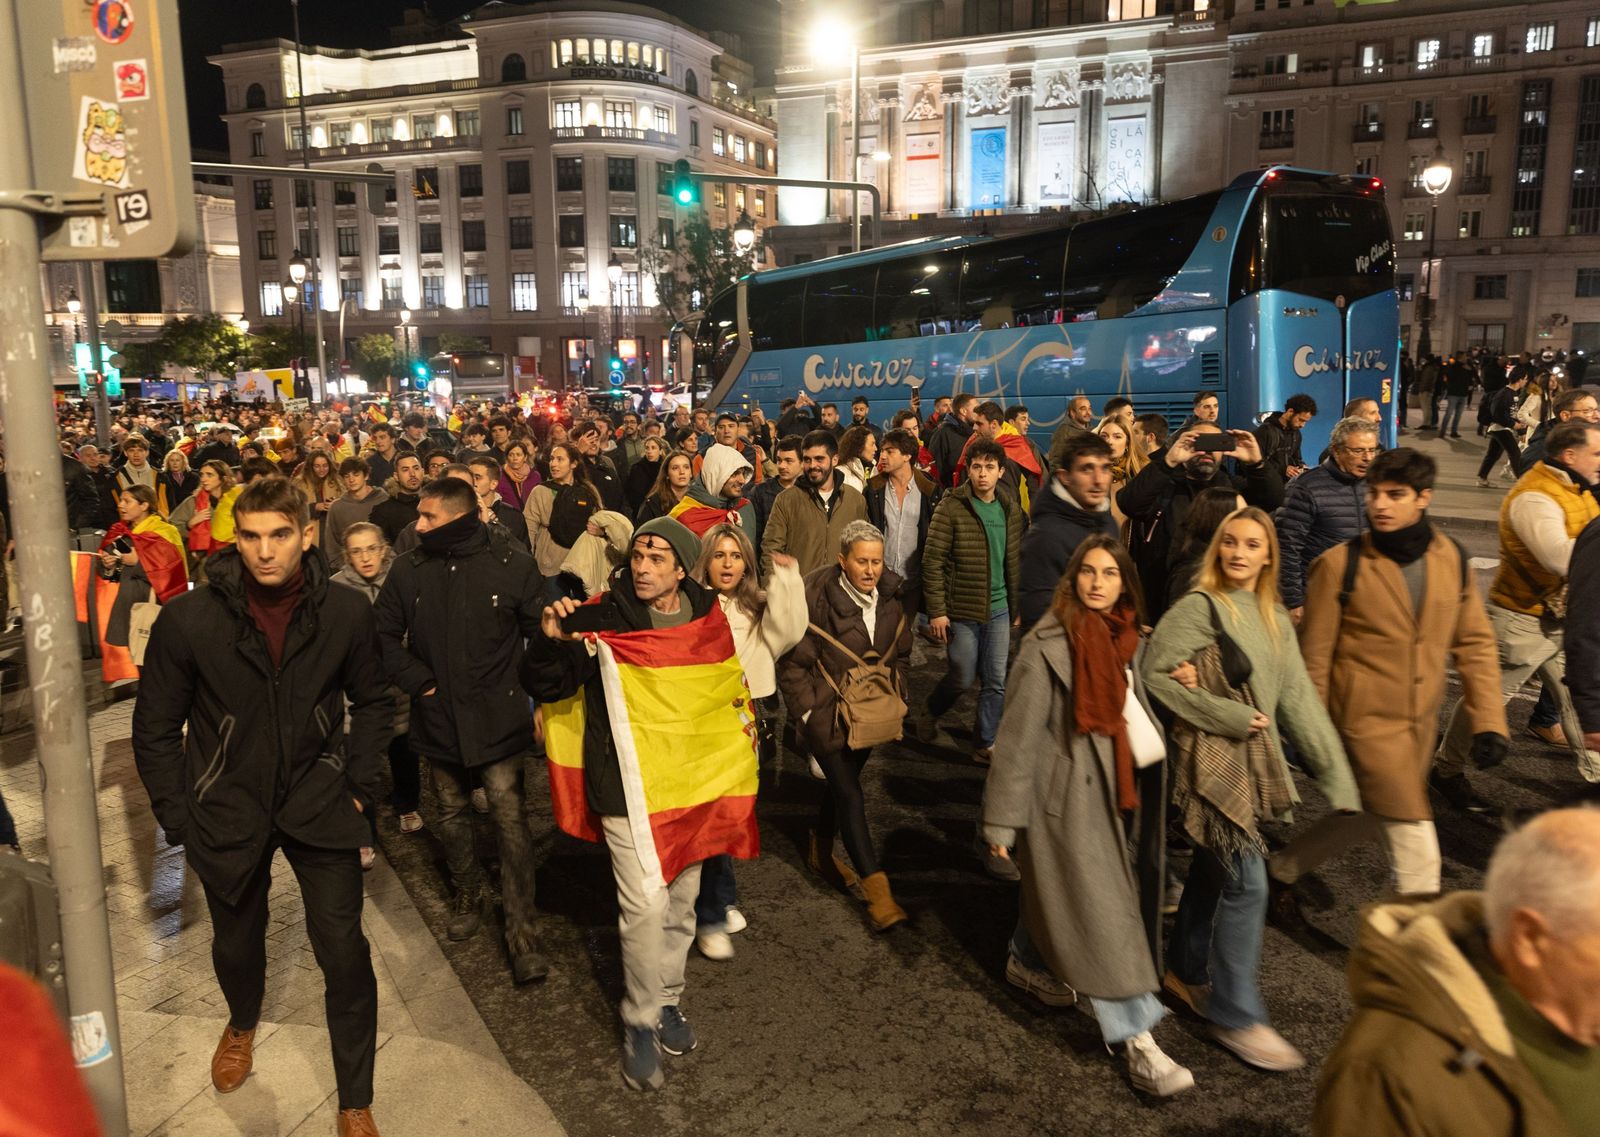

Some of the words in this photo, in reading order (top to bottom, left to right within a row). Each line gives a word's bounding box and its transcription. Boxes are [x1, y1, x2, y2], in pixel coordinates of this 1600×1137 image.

[571, 67, 617, 79] EDIFICIO
[622, 68, 660, 84] ZURICH
[1355, 255, 1370, 273] Vip
[1370, 239, 1390, 263] Class
